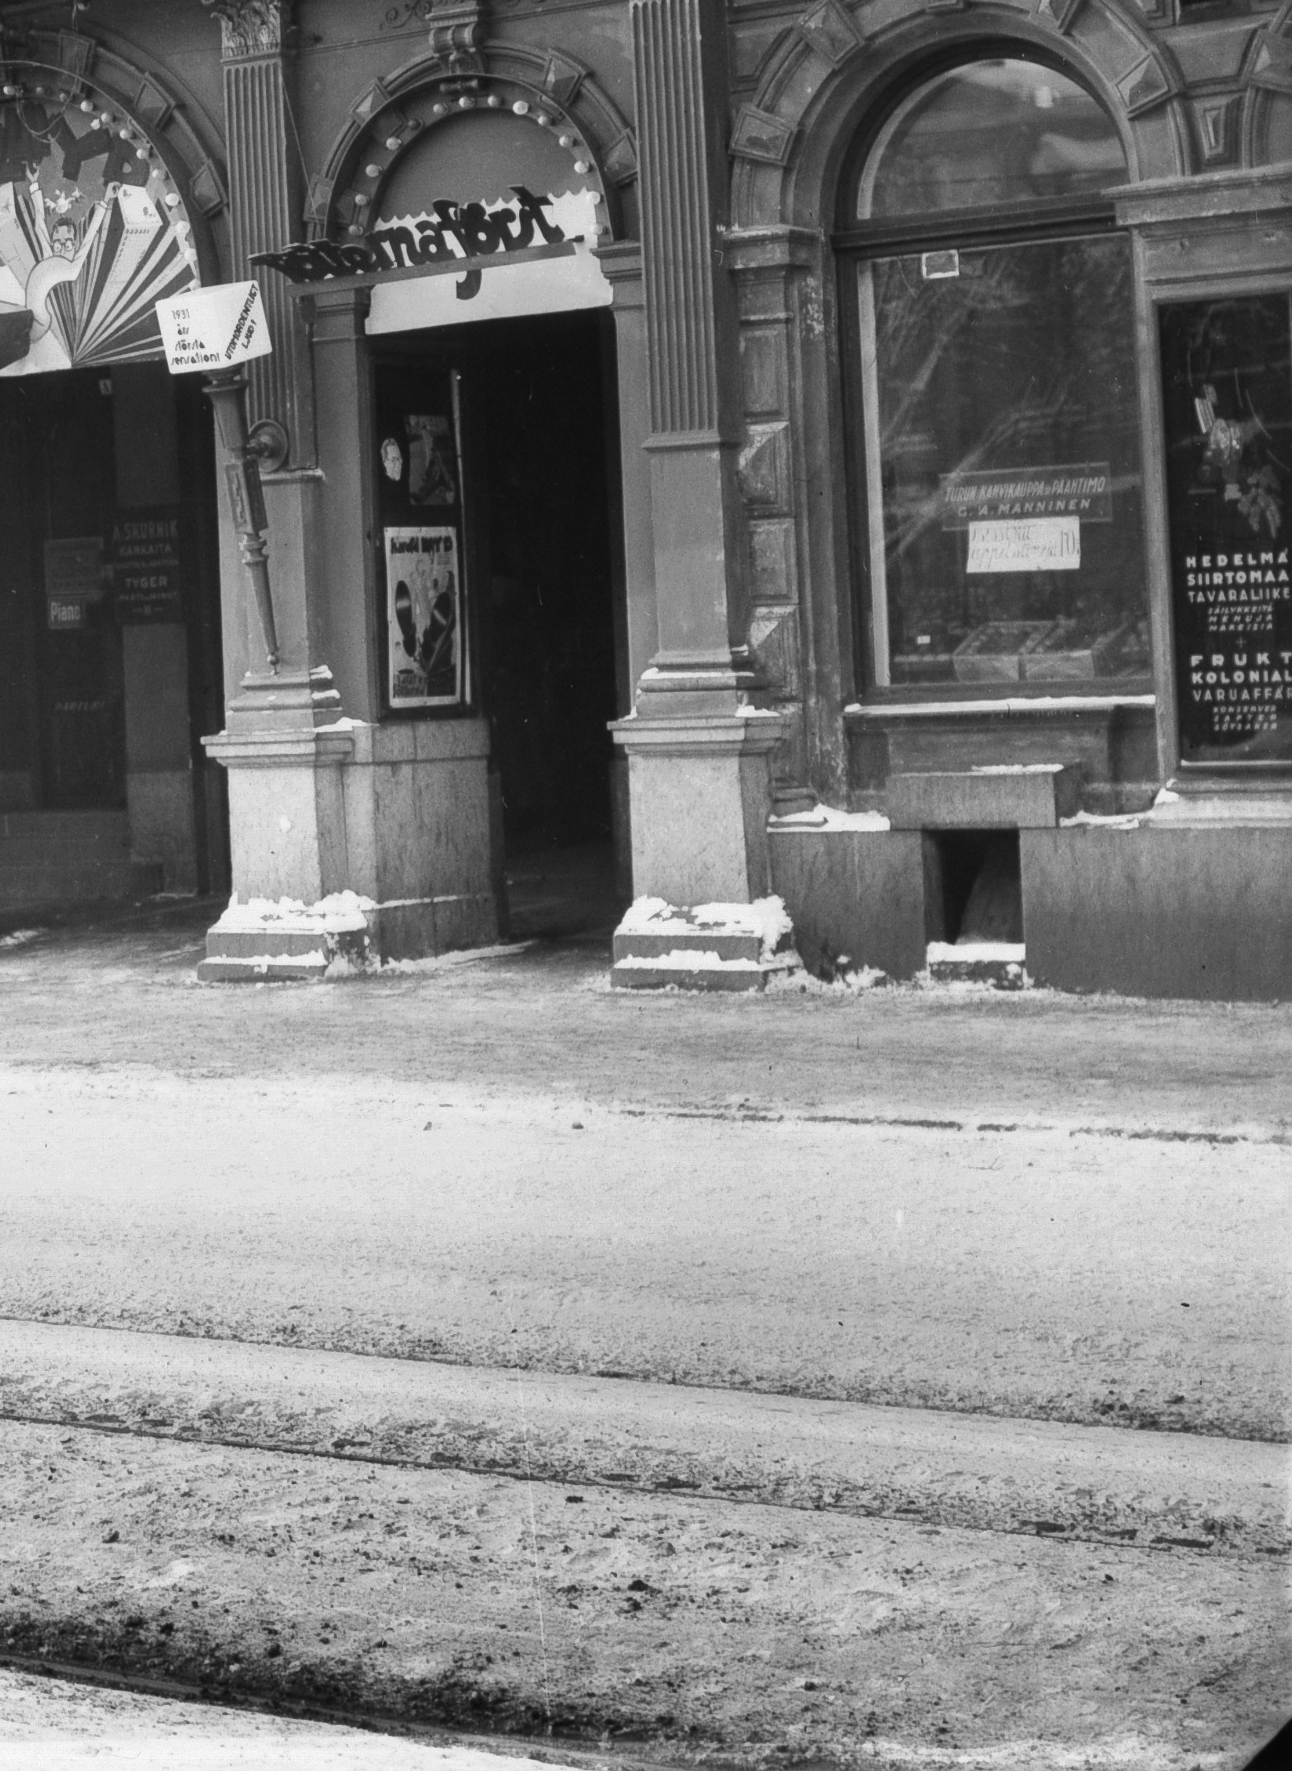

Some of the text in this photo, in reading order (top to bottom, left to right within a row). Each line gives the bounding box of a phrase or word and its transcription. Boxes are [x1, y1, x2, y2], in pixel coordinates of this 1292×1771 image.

[171, 308, 191, 320] 1931
[944, 485, 978, 503] TURUN
[979, 480, 1045, 500] KAHVIKAUPPA
[1052, 476, 1107, 495] PAAHTIMO
[997, 498, 1092, 515] MANNINEN
[1187, 568, 1290, 587] SIIRTOMAA
[1187, 586, 1291, 603] TAVARALIIKE
[50, 600, 82, 622] Piano
[1190, 651, 1292, 668] FRUKT
[1191, 669, 1292, 685] KOLONIAL
